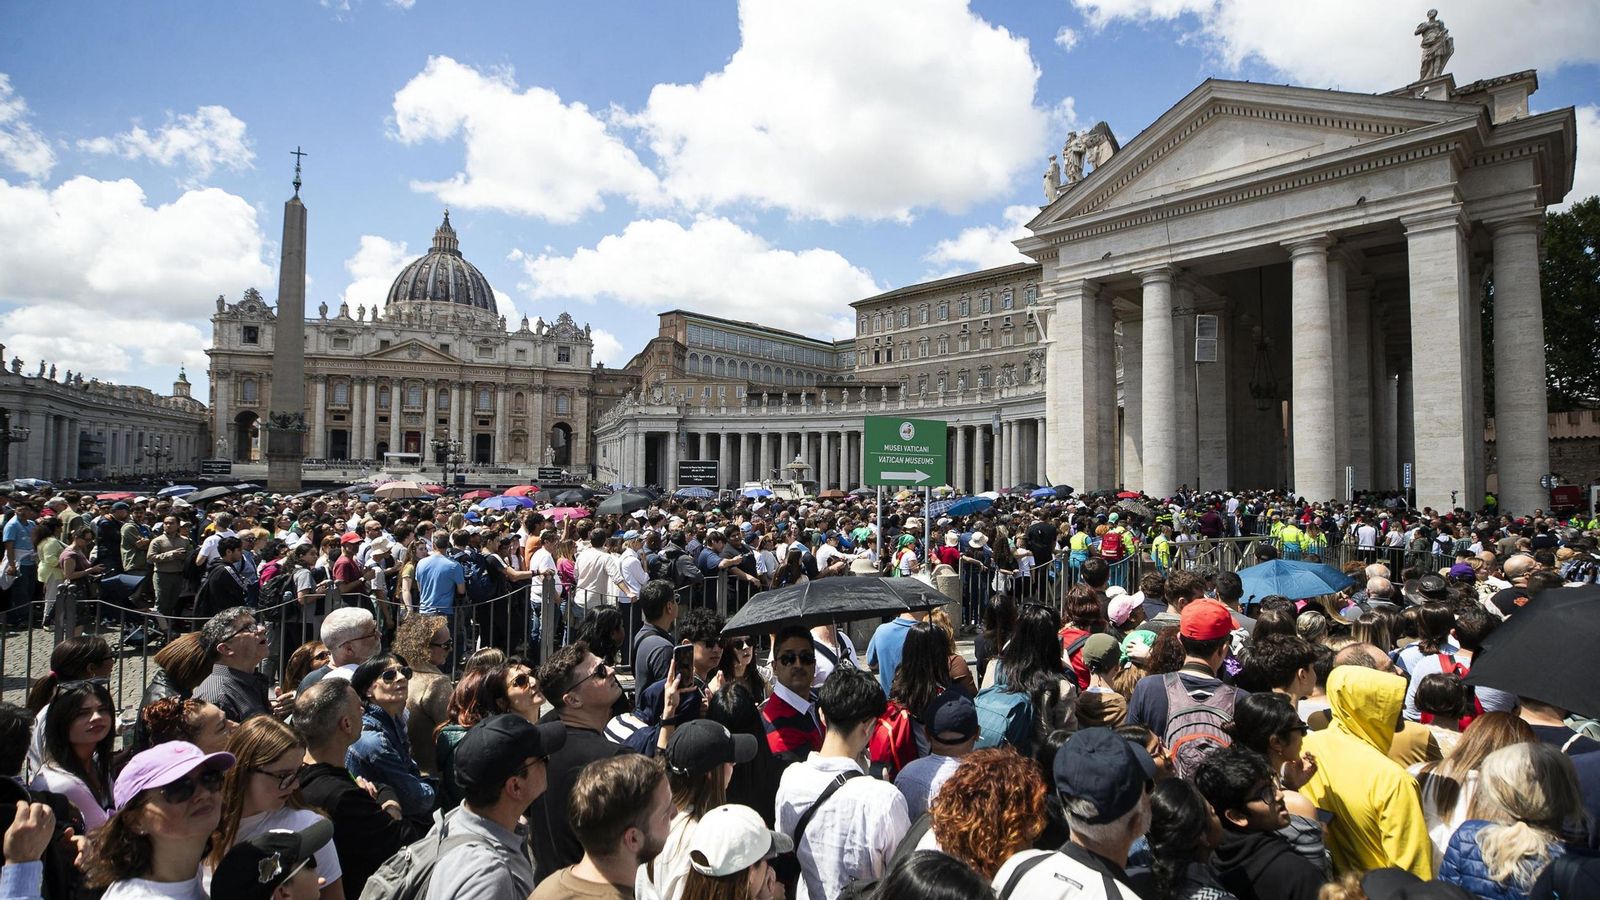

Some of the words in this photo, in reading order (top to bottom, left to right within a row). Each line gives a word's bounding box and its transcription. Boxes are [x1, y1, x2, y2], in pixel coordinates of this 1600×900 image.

[884, 444, 903, 452] MUSEI
[904, 445, 930, 453] VATICANI
[879, 455, 904, 464] VATICAN
[905, 456, 934, 465] MUSEUMS
